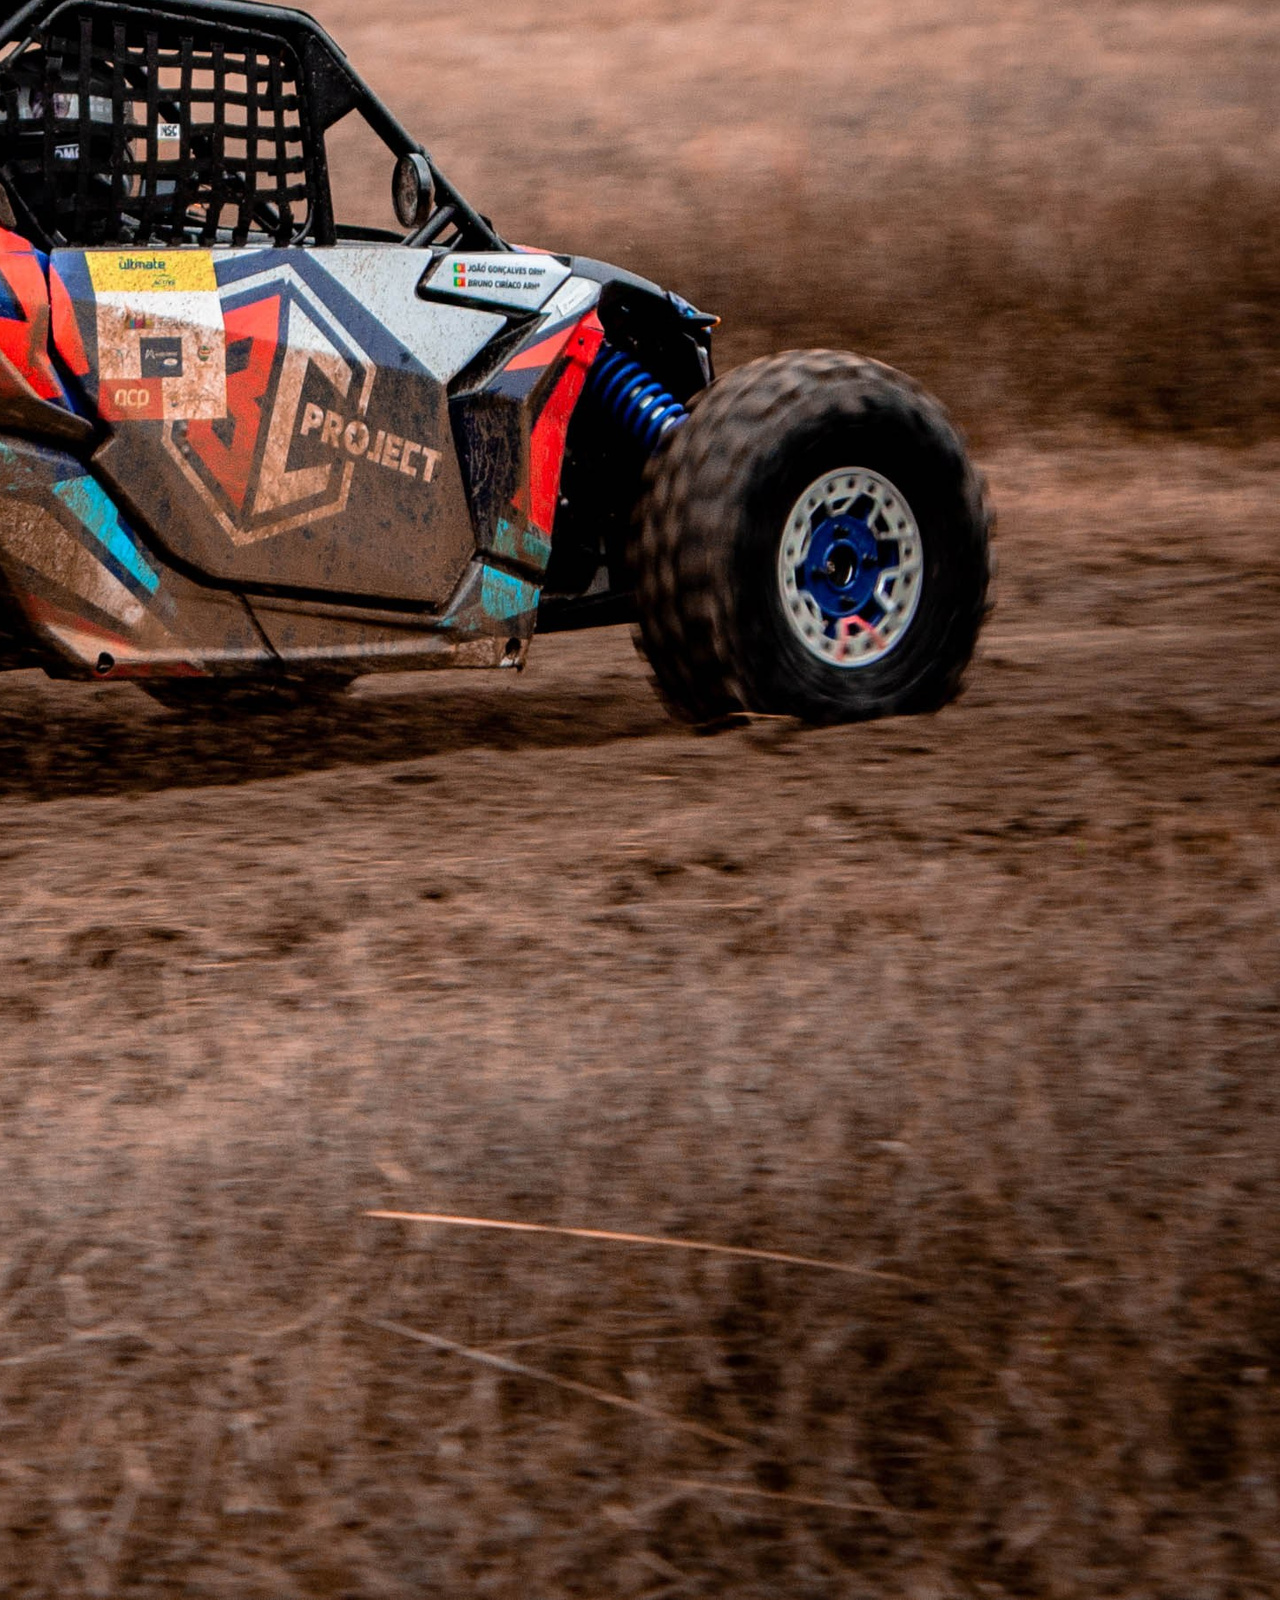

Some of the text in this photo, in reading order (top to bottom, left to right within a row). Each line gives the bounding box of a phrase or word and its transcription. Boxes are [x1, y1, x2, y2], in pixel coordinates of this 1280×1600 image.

[118, 258, 166, 270] ultimate
[468, 263, 486, 273] JOÃO
[488, 265, 527, 276] GONÇALVES
[467, 278, 493, 288] BRUNO
[494, 279, 521, 289] CIRÍACO
[114, 389, 150, 408] acp
[299, 402, 443, 483] PROJECT
